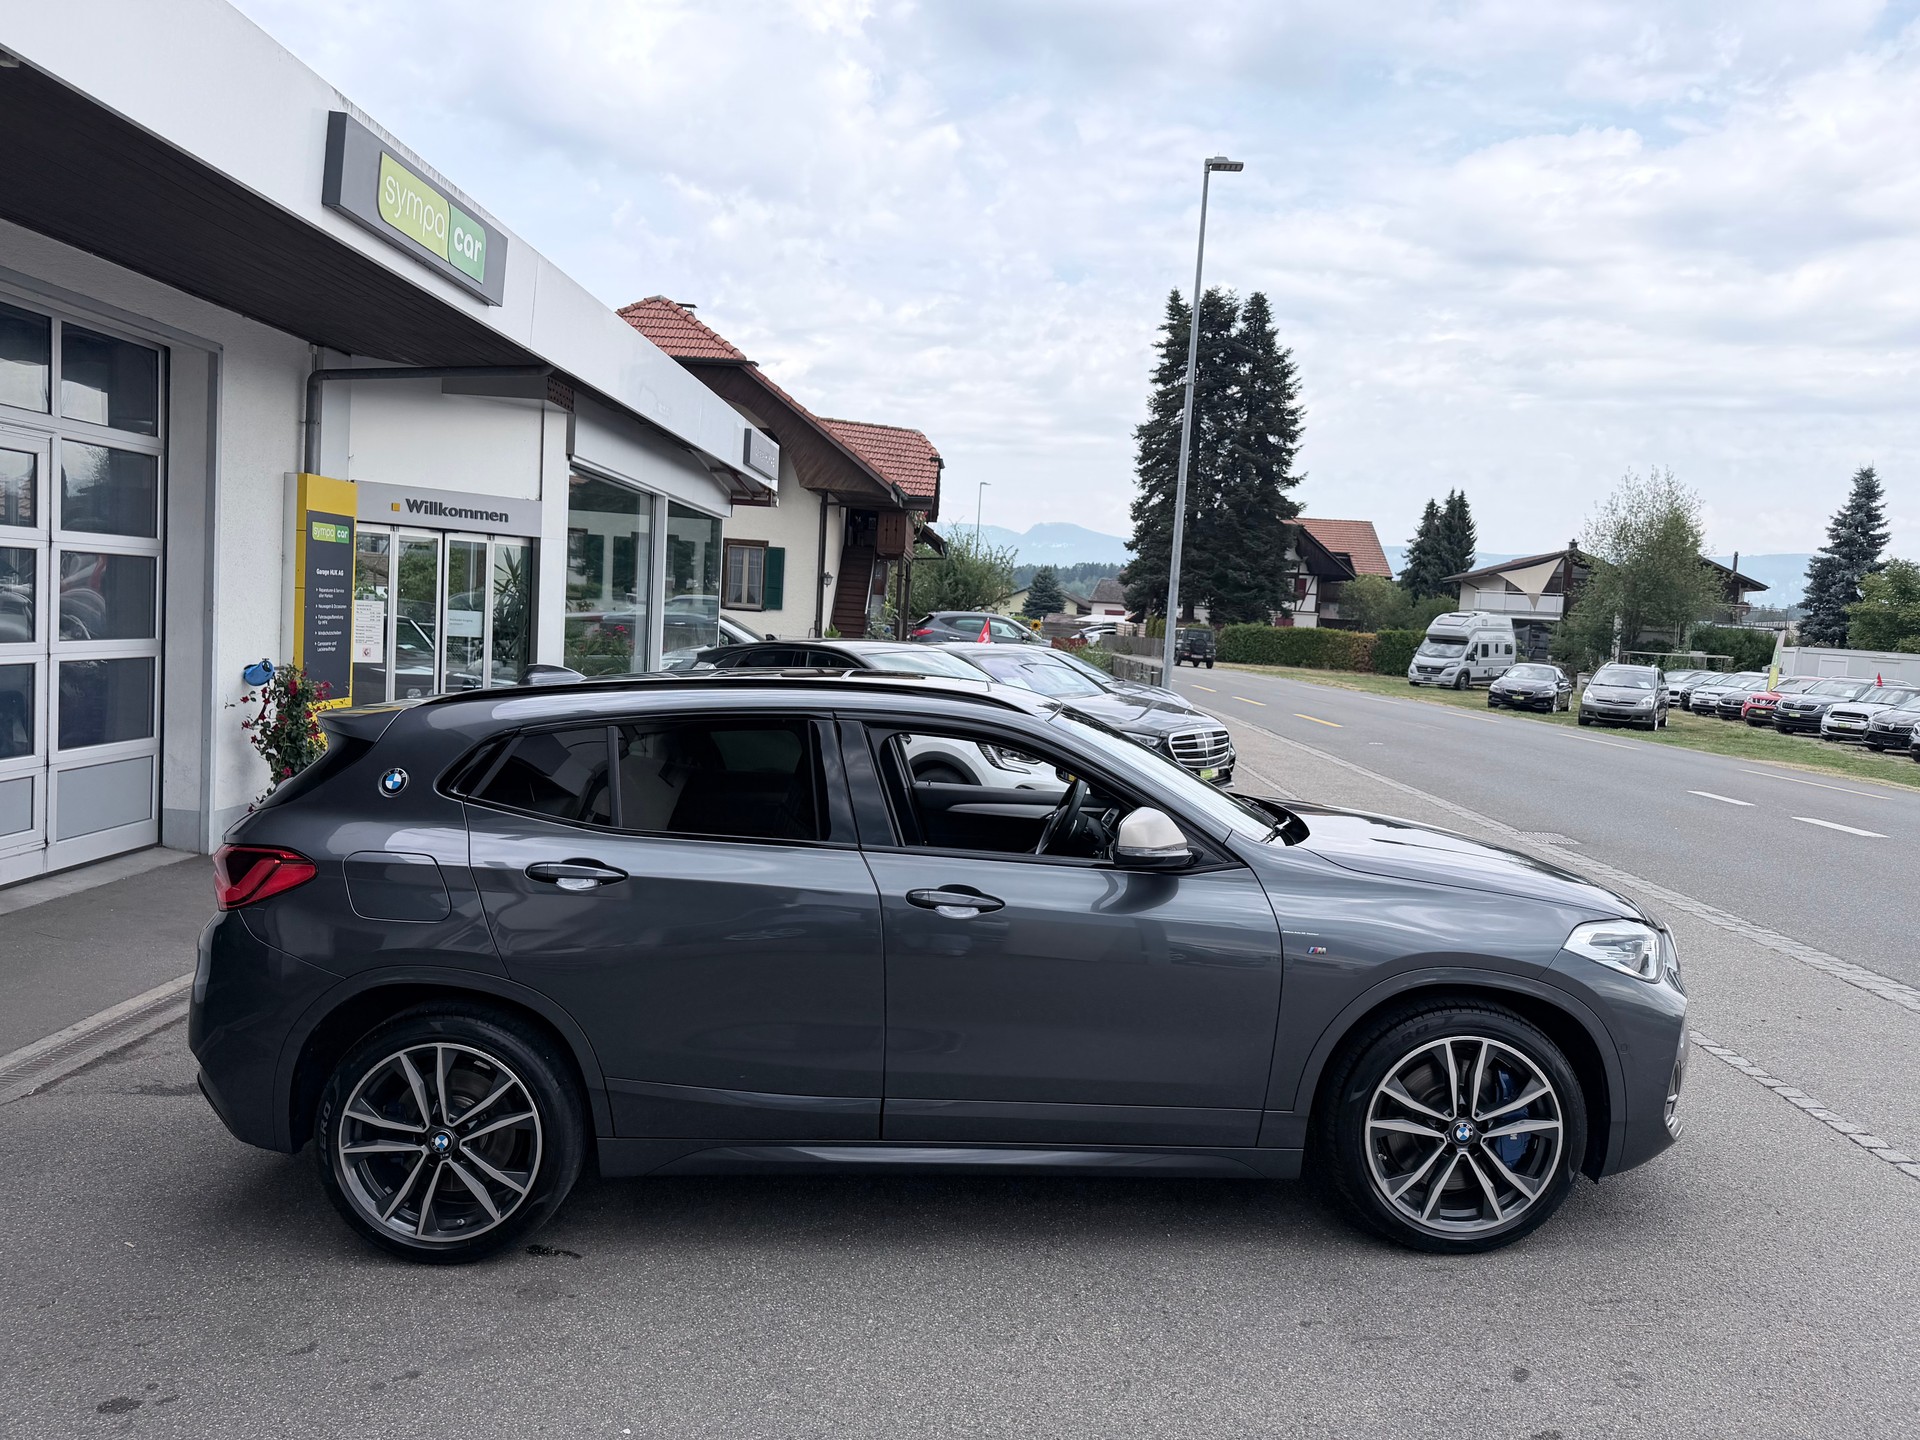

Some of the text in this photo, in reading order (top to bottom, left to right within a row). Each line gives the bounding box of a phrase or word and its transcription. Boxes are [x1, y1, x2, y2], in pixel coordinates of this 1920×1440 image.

[385, 176, 483, 263] sympa car
[405, 498, 509, 523] Willkommen
[337, 530, 348, 539] car
